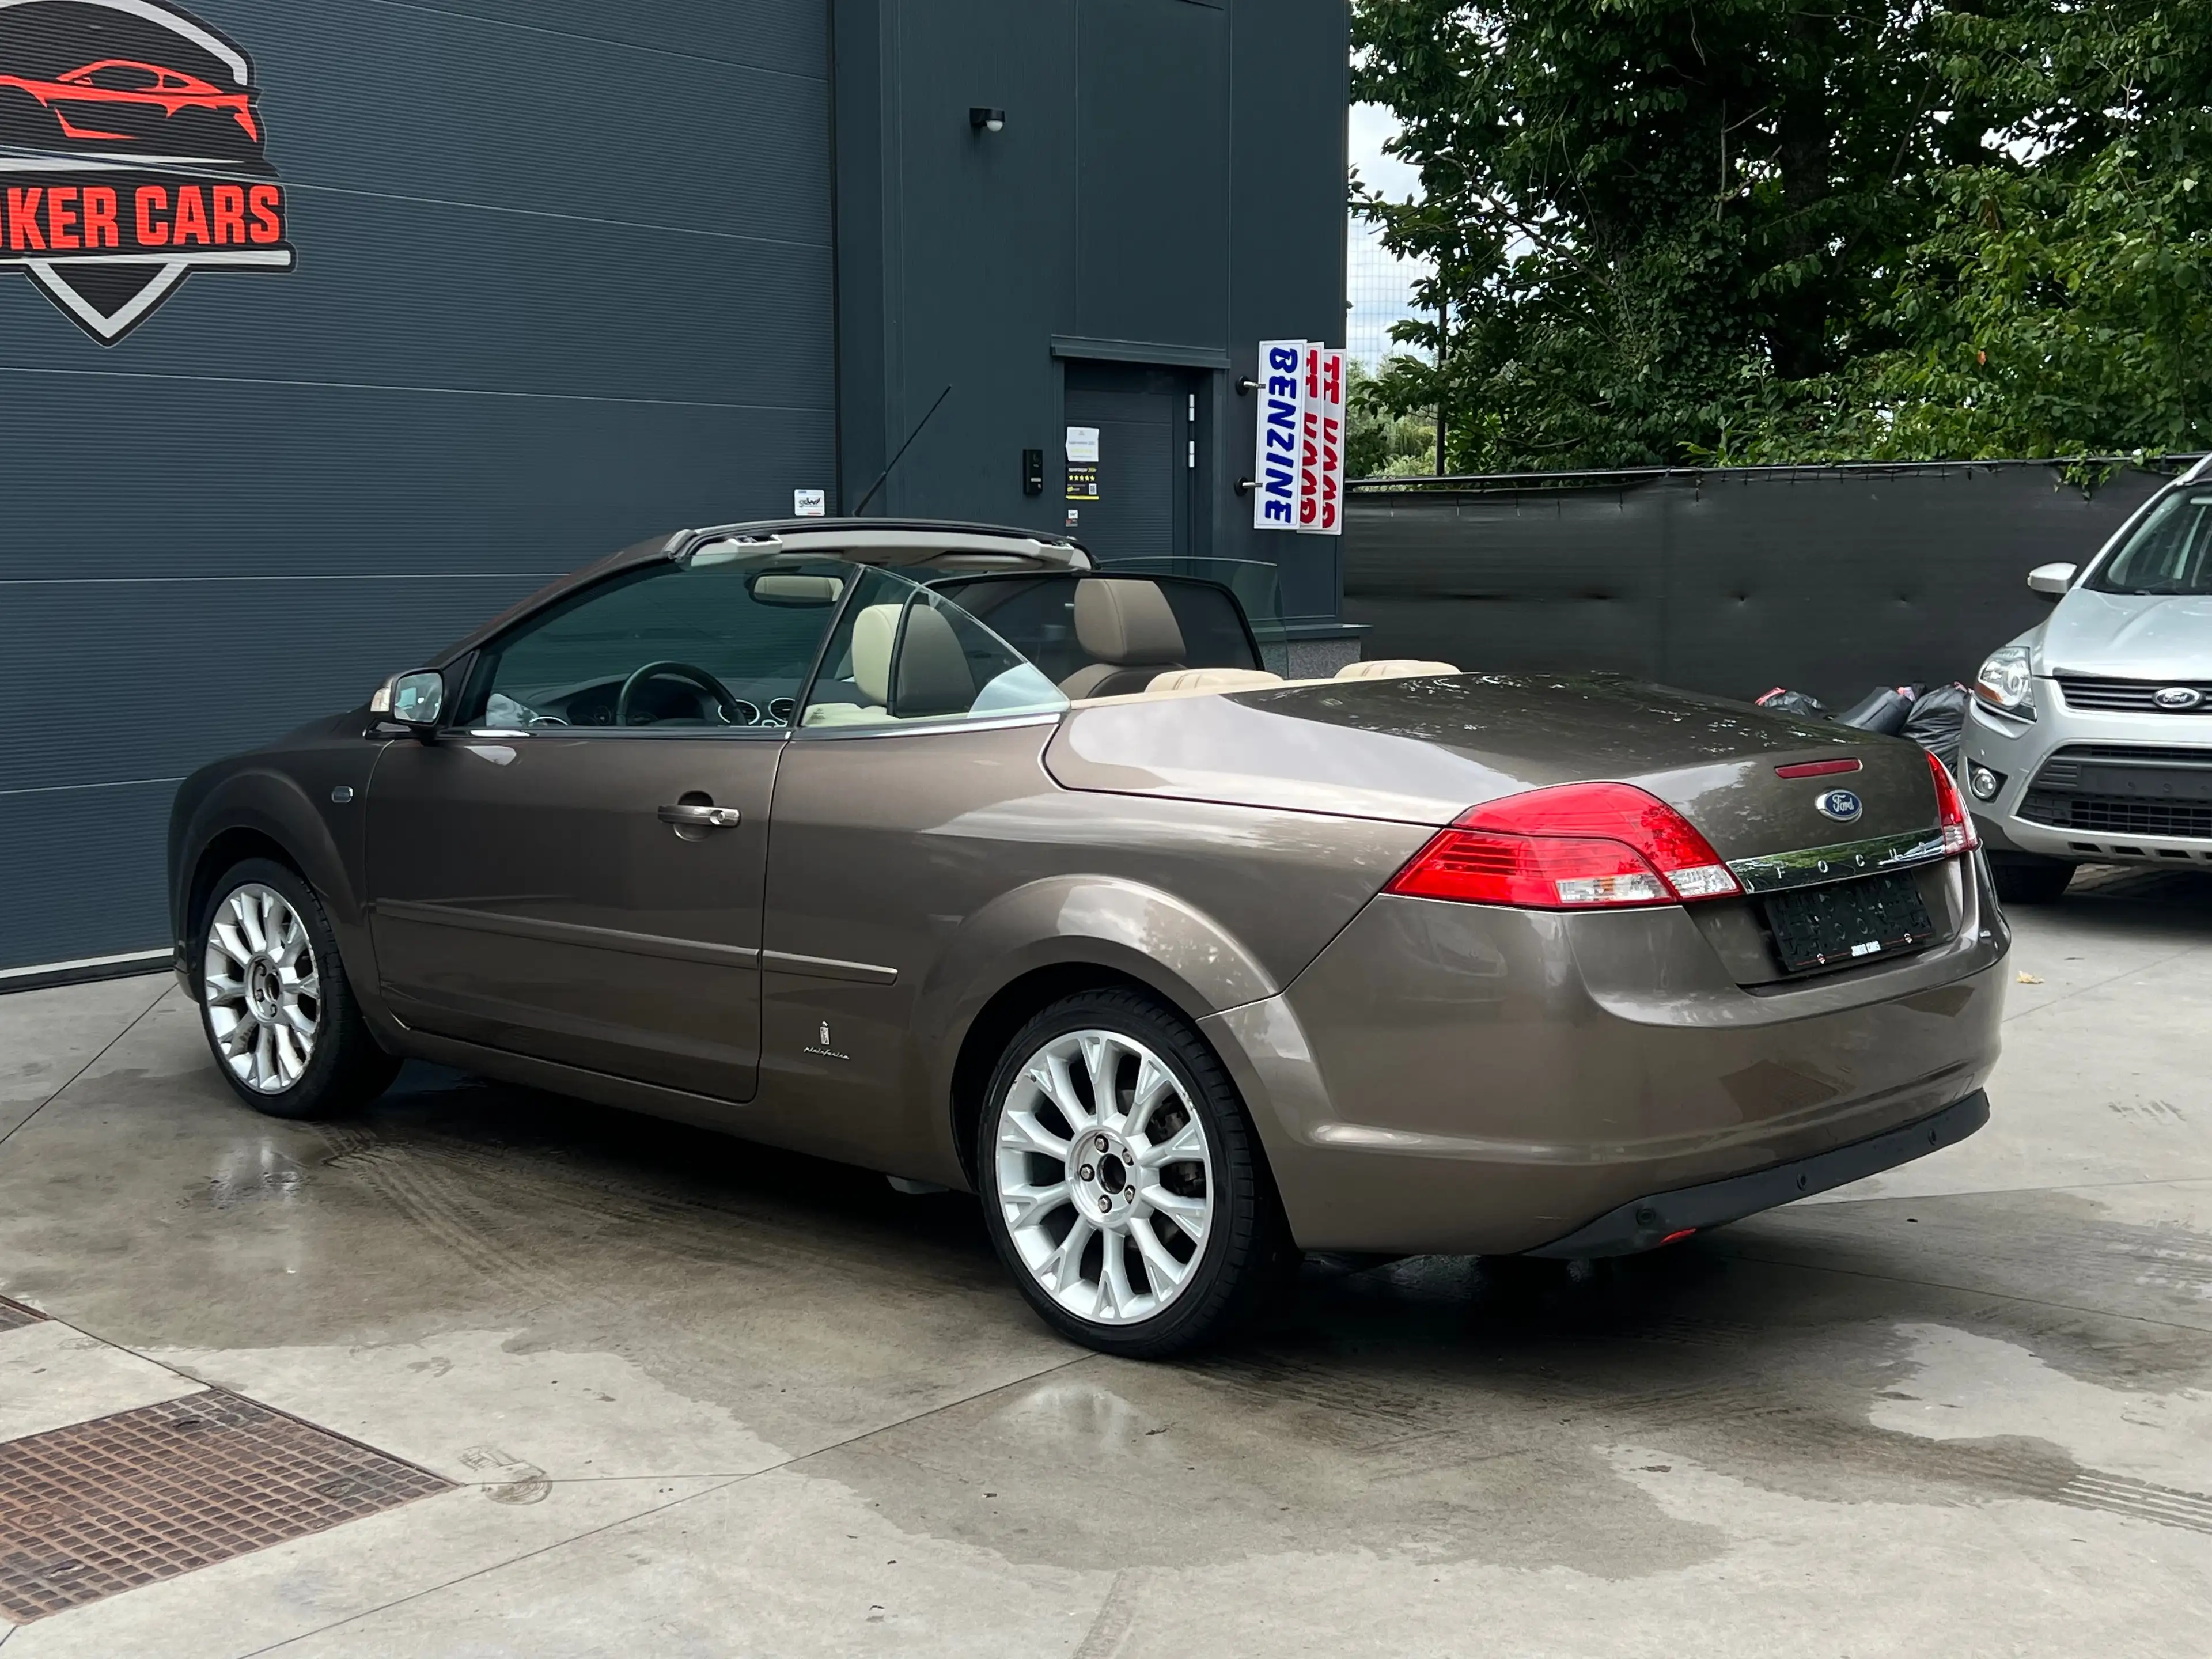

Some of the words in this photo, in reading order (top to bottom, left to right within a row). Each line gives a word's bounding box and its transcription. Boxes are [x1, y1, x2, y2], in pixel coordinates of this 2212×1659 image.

[0, 185, 119, 250] KER
[135, 185, 280, 246] CARS
[1264, 347, 1298, 523] BENZINE
[1832, 794, 1855, 812] Ford
